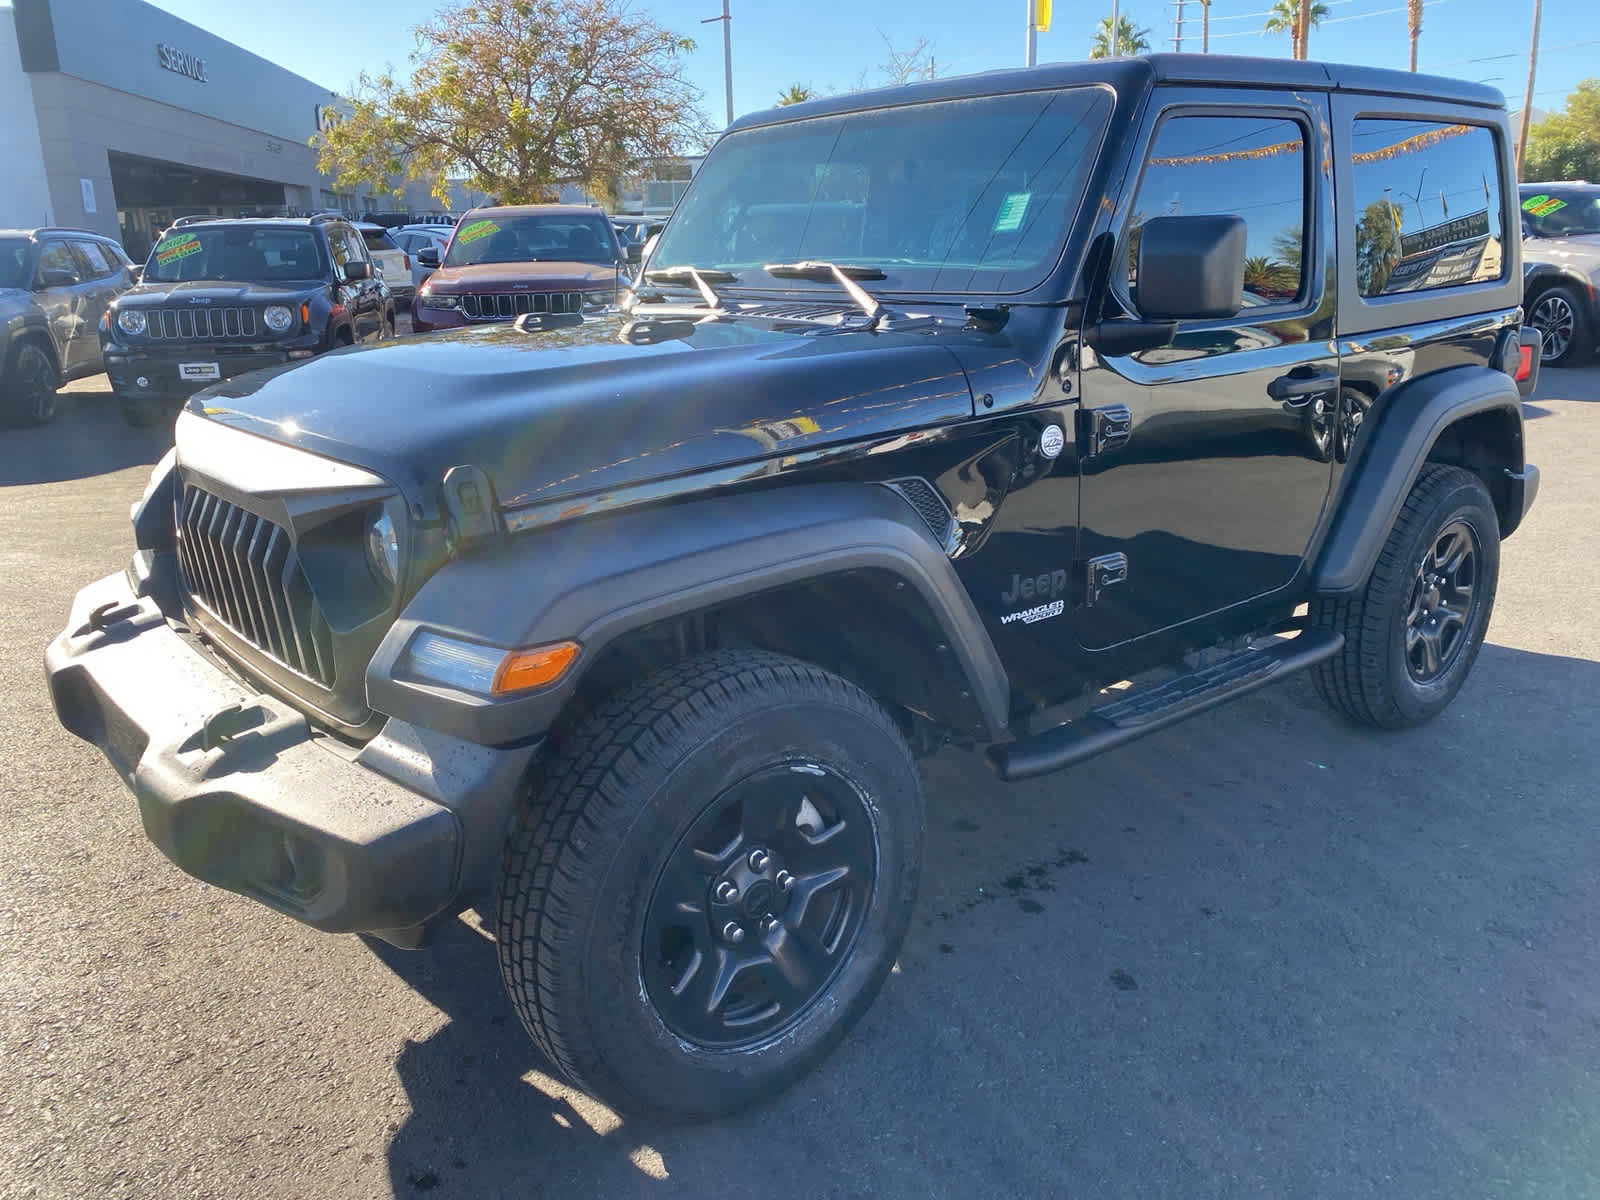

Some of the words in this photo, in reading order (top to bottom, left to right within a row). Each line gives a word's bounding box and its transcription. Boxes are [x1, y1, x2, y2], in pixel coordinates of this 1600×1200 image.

[158, 42, 208, 83] SERVICE
[1001, 569, 1066, 604] Jeep
[1000, 599, 1065, 625] WRANGLER
